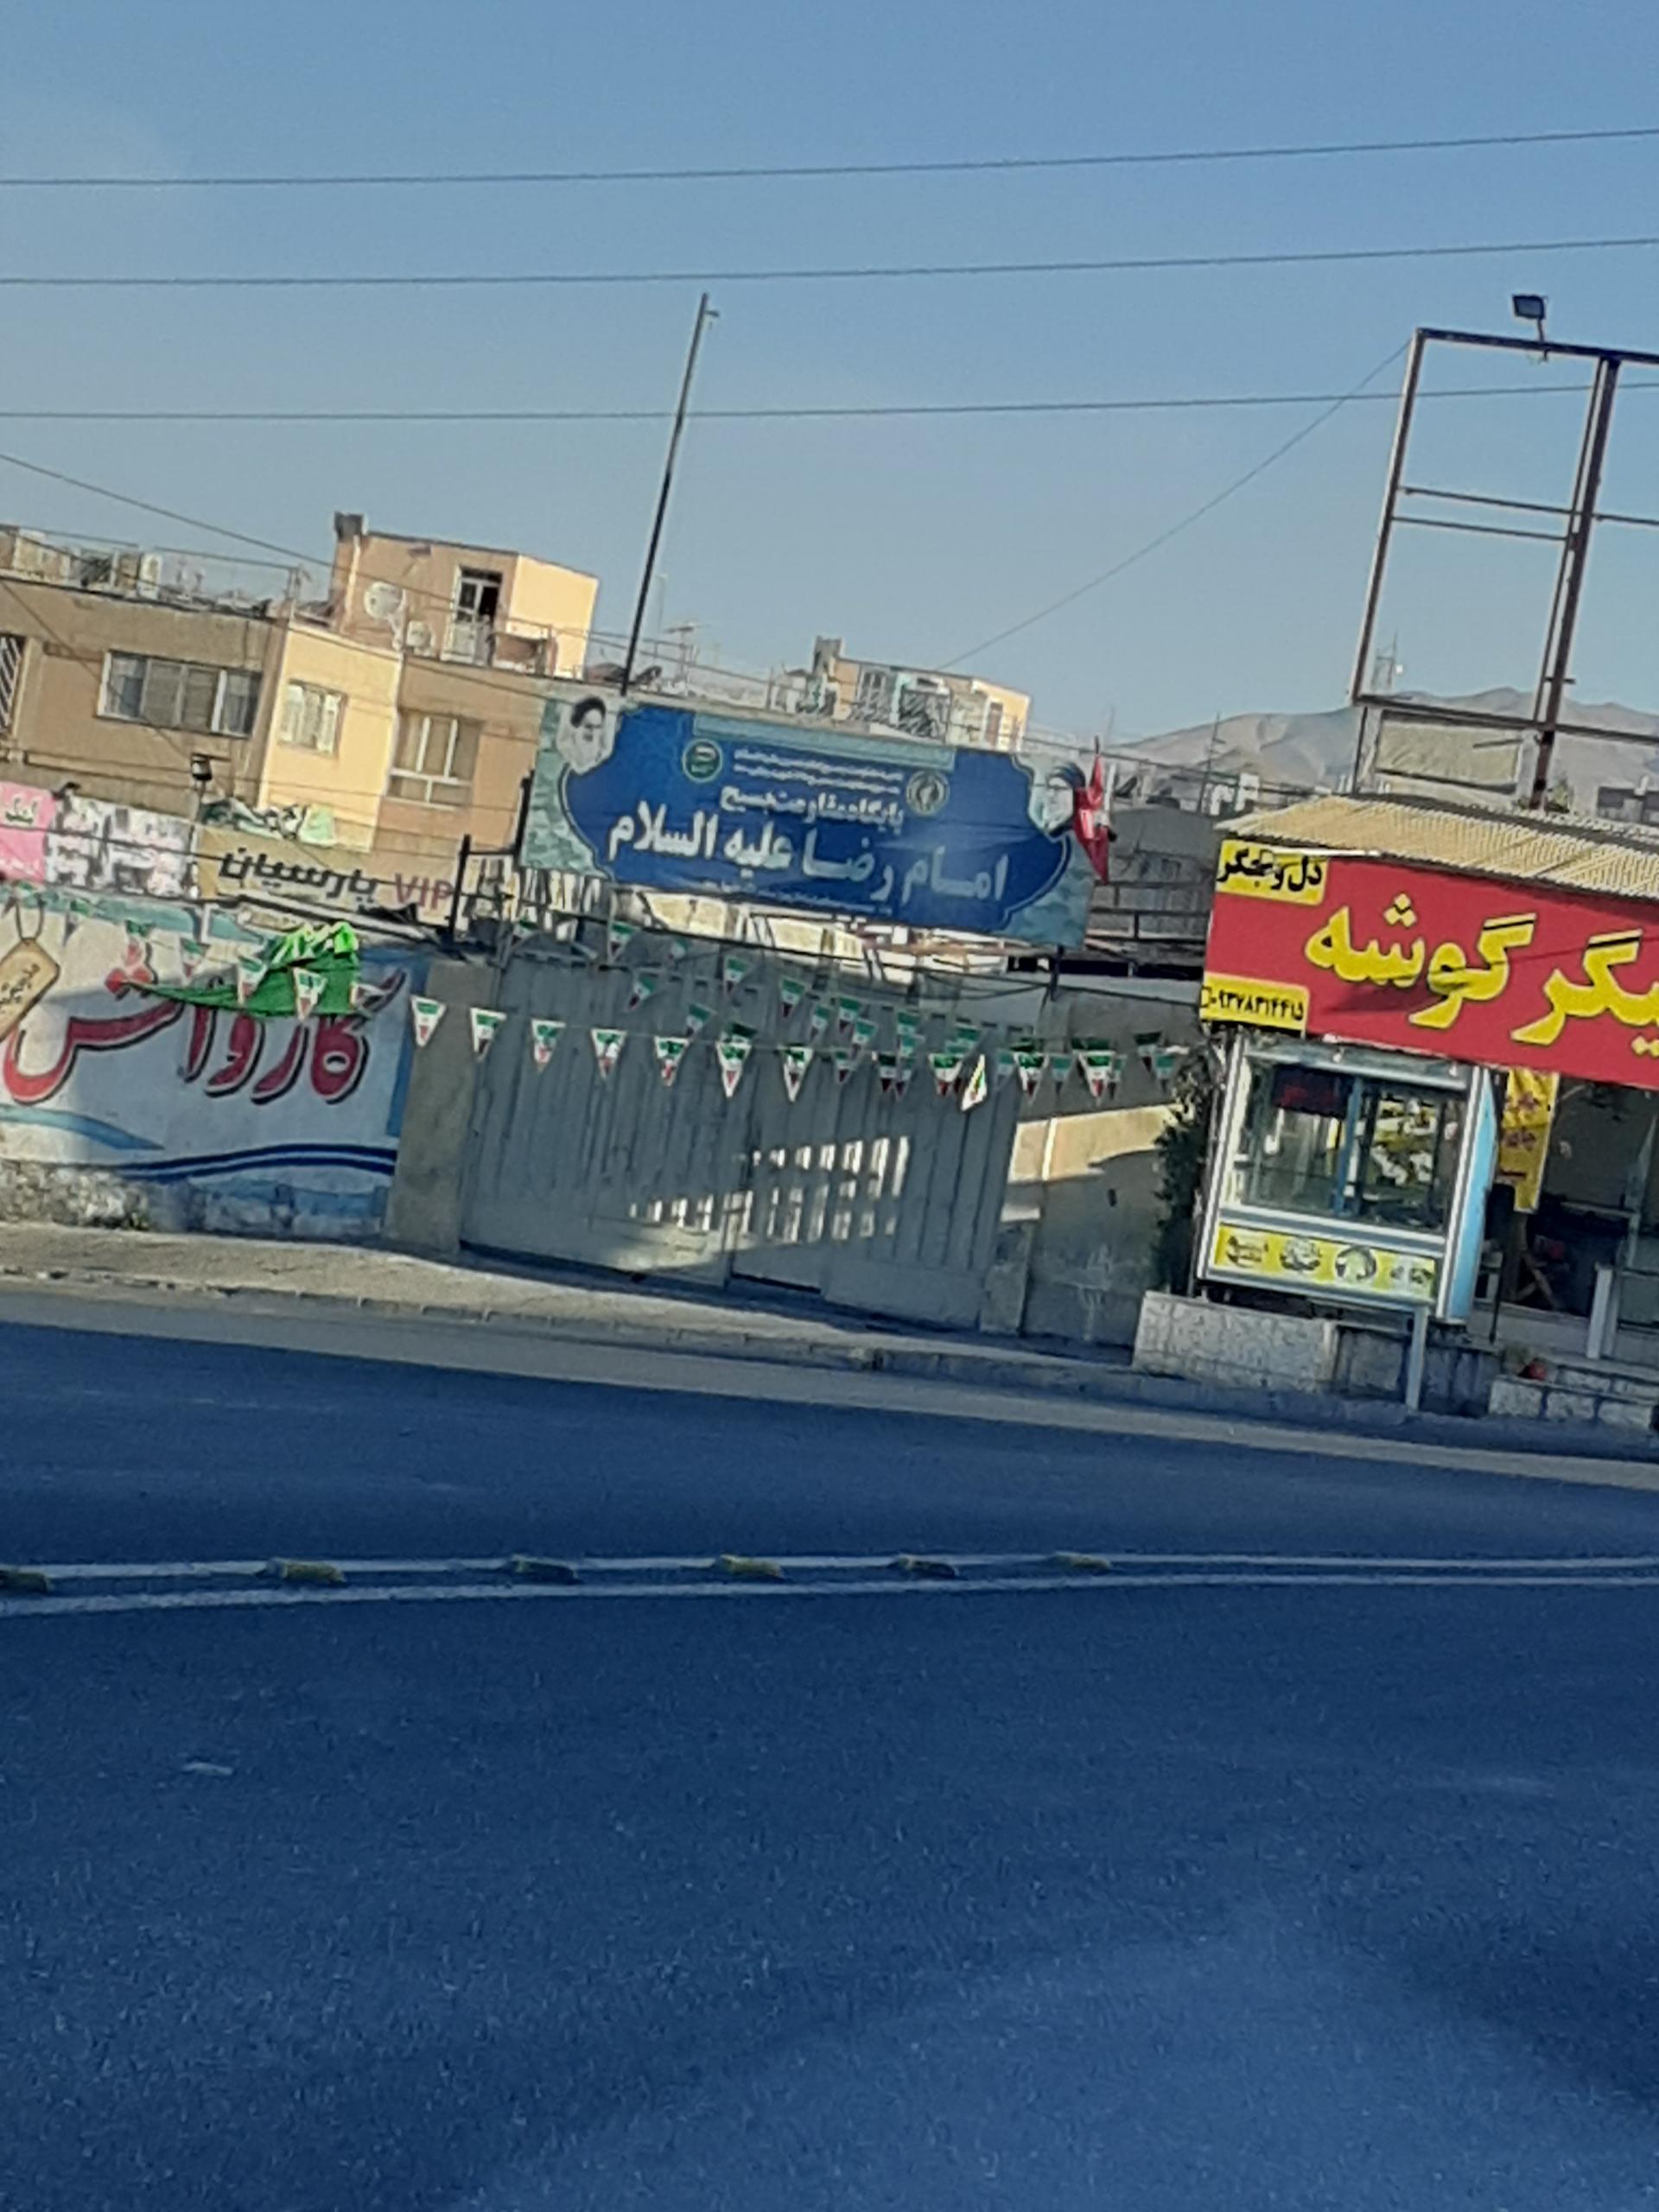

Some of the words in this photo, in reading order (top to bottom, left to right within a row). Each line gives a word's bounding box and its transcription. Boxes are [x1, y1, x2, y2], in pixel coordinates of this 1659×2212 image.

[720, 785, 776, 816] بسیج
[849, 795, 905, 832] پایگاه
[607, 800, 718, 862] السلام
[724, 818, 794, 878] علیه
[219, 847, 380, 904] پارسیان
[394, 872, 454, 911] VIP
[800, 827, 893, 902] رضا
[901, 842, 1009, 904] امام
[1216, 847, 1274, 888] جگر
[1287, 855, 1323, 892] دل
[1304, 892, 1538, 1031] گوشه
[1510, 928, 1659, 1058] یگر
